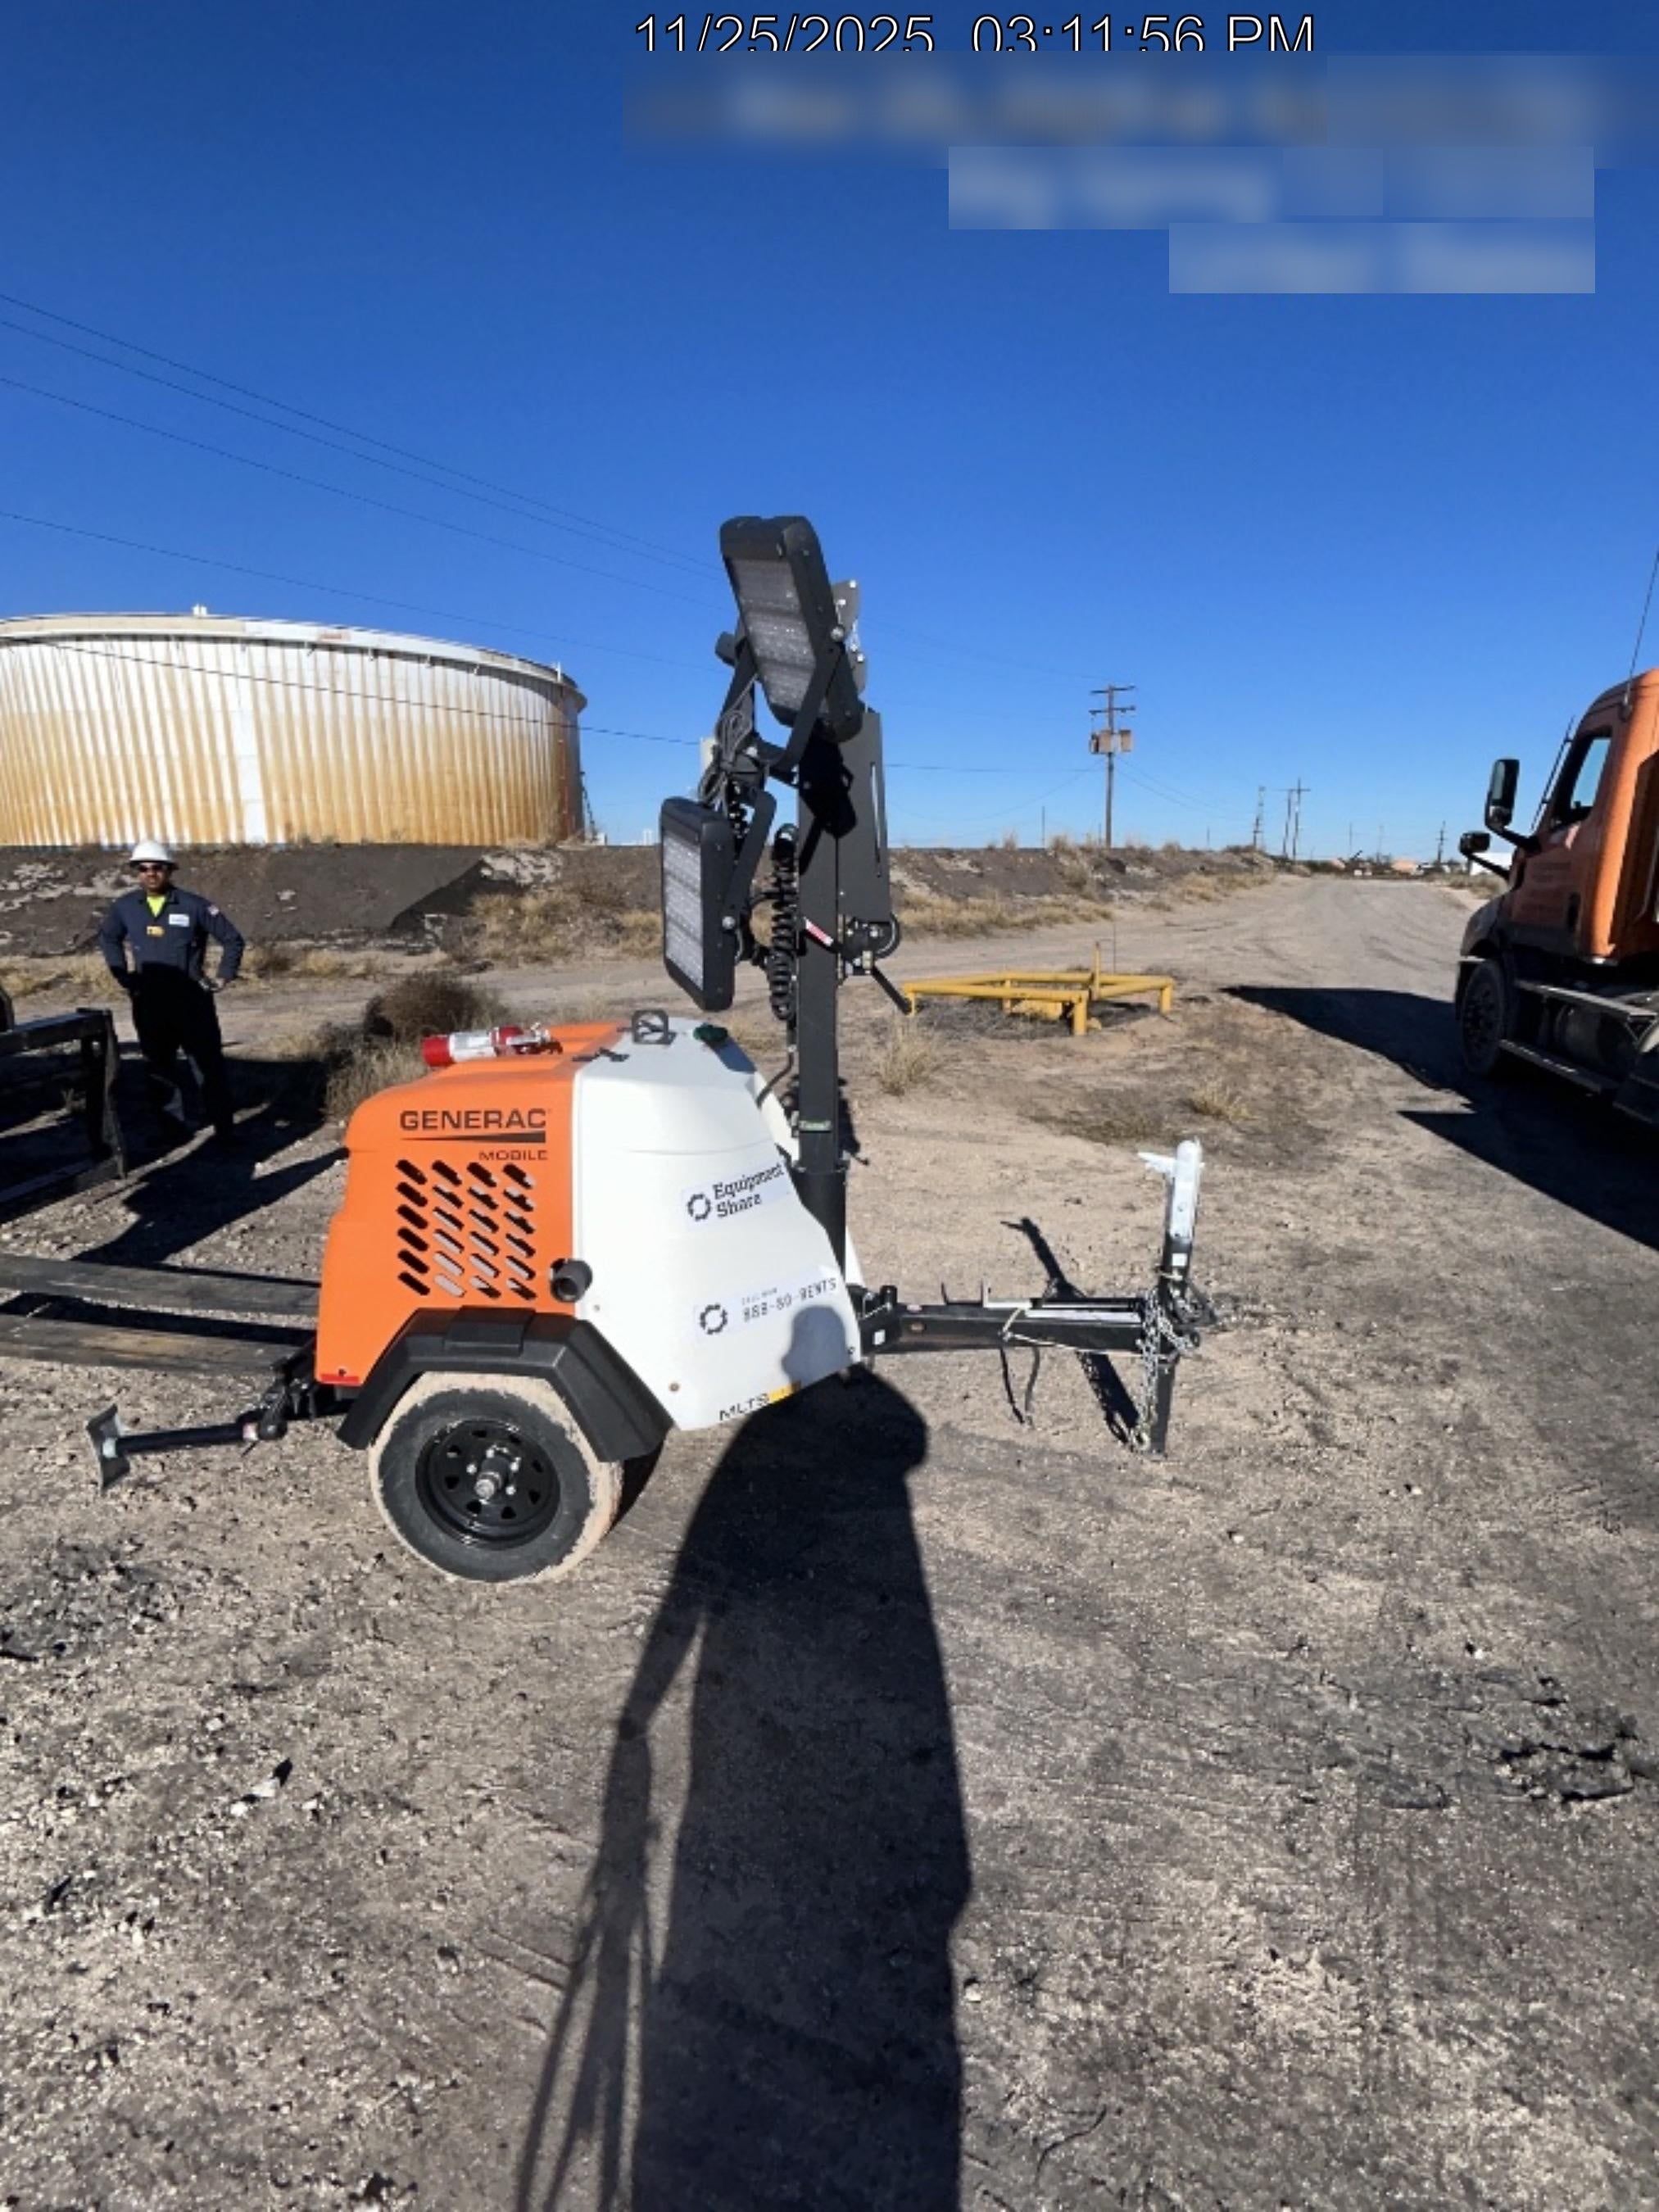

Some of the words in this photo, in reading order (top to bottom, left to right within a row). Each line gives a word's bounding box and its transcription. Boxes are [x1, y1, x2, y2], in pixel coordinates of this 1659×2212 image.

[400, 1108, 546, 1131] GENERAC
[479, 1149, 548, 1161] MOBILE
[712, 1163, 784, 1199] Equipment
[716, 1194, 761, 1218] Share
